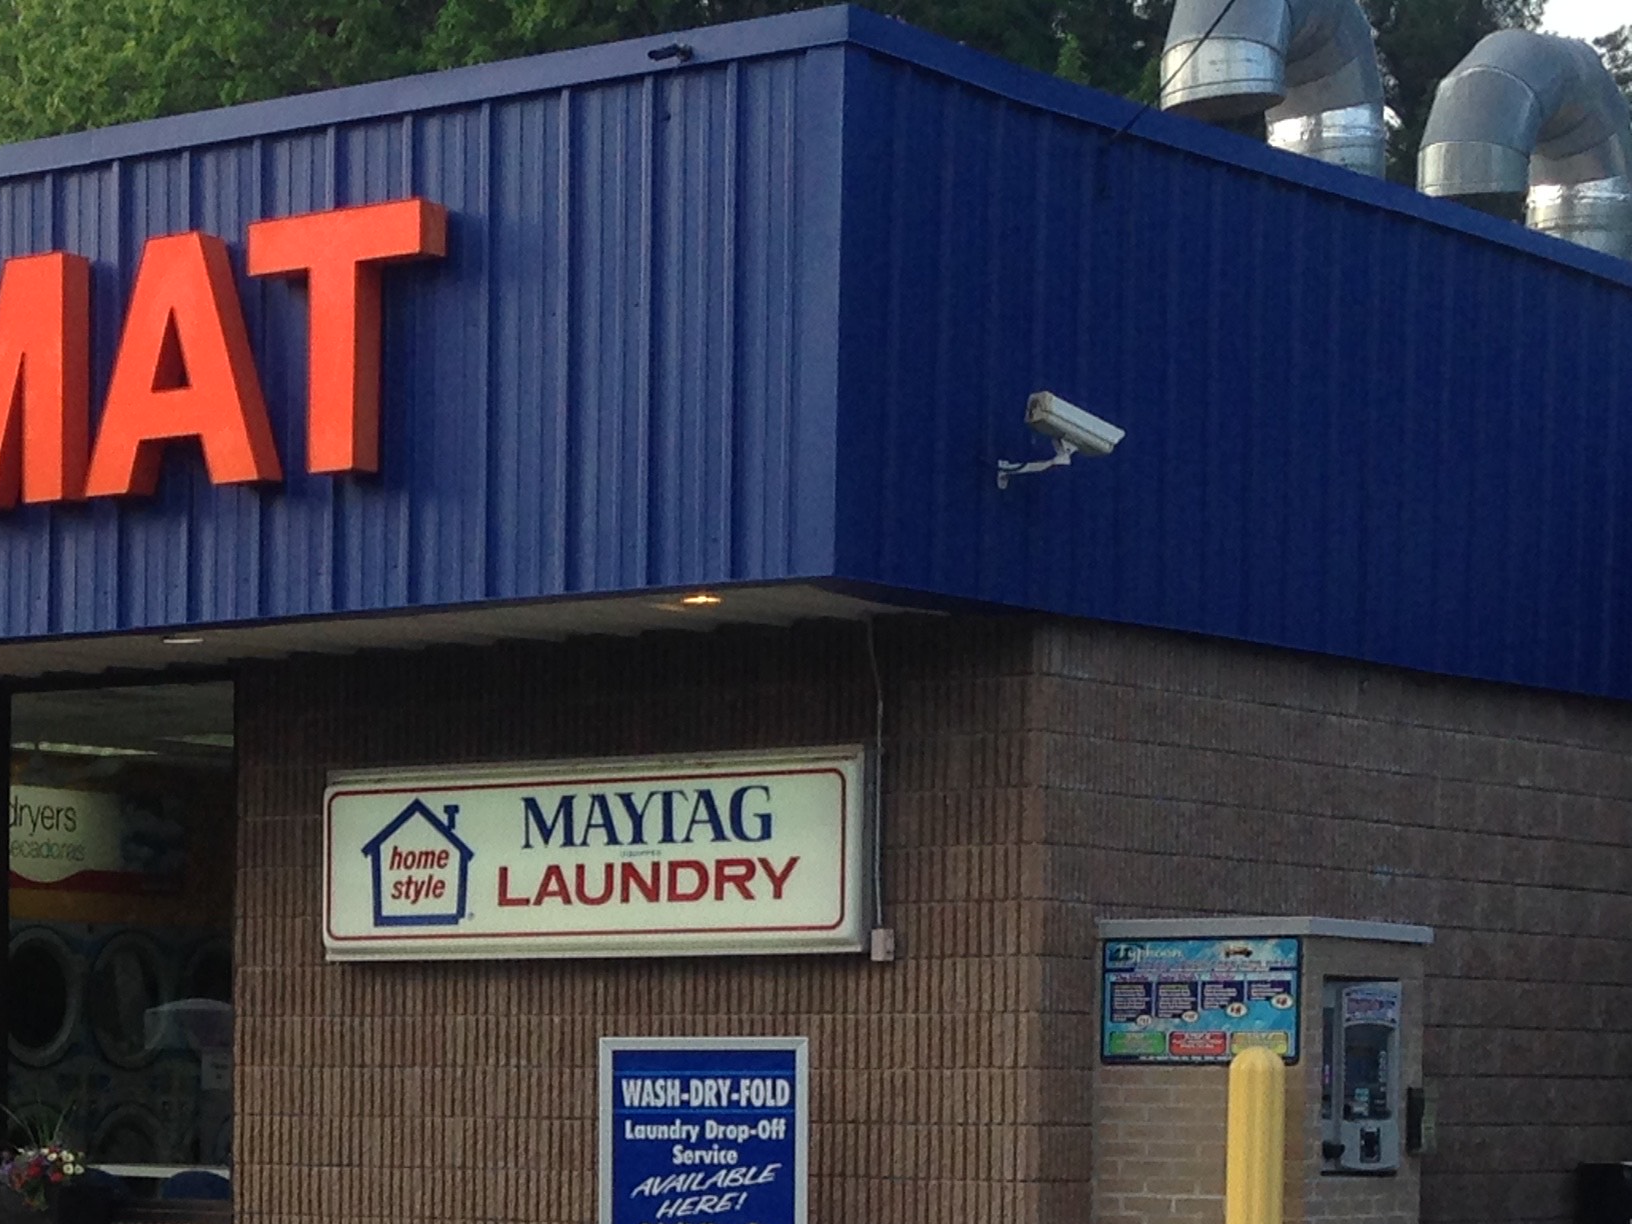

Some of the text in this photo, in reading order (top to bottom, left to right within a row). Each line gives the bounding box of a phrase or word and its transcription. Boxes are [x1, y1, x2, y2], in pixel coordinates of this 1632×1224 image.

[521, 784, 773, 850] MAYTAG
[389, 846, 450, 871] home
[390, 875, 446, 904] style
[497, 856, 800, 908] LAUNDRY
[621, 1078, 791, 1108] WASH-DRY-FOLD
[624, 1117, 786, 1144] Laundry Drop-Off
[672, 1144, 738, 1165] Service
[630, 1163, 783, 1199] AVAILABLE
[655, 1191, 748, 1219] HERE!
